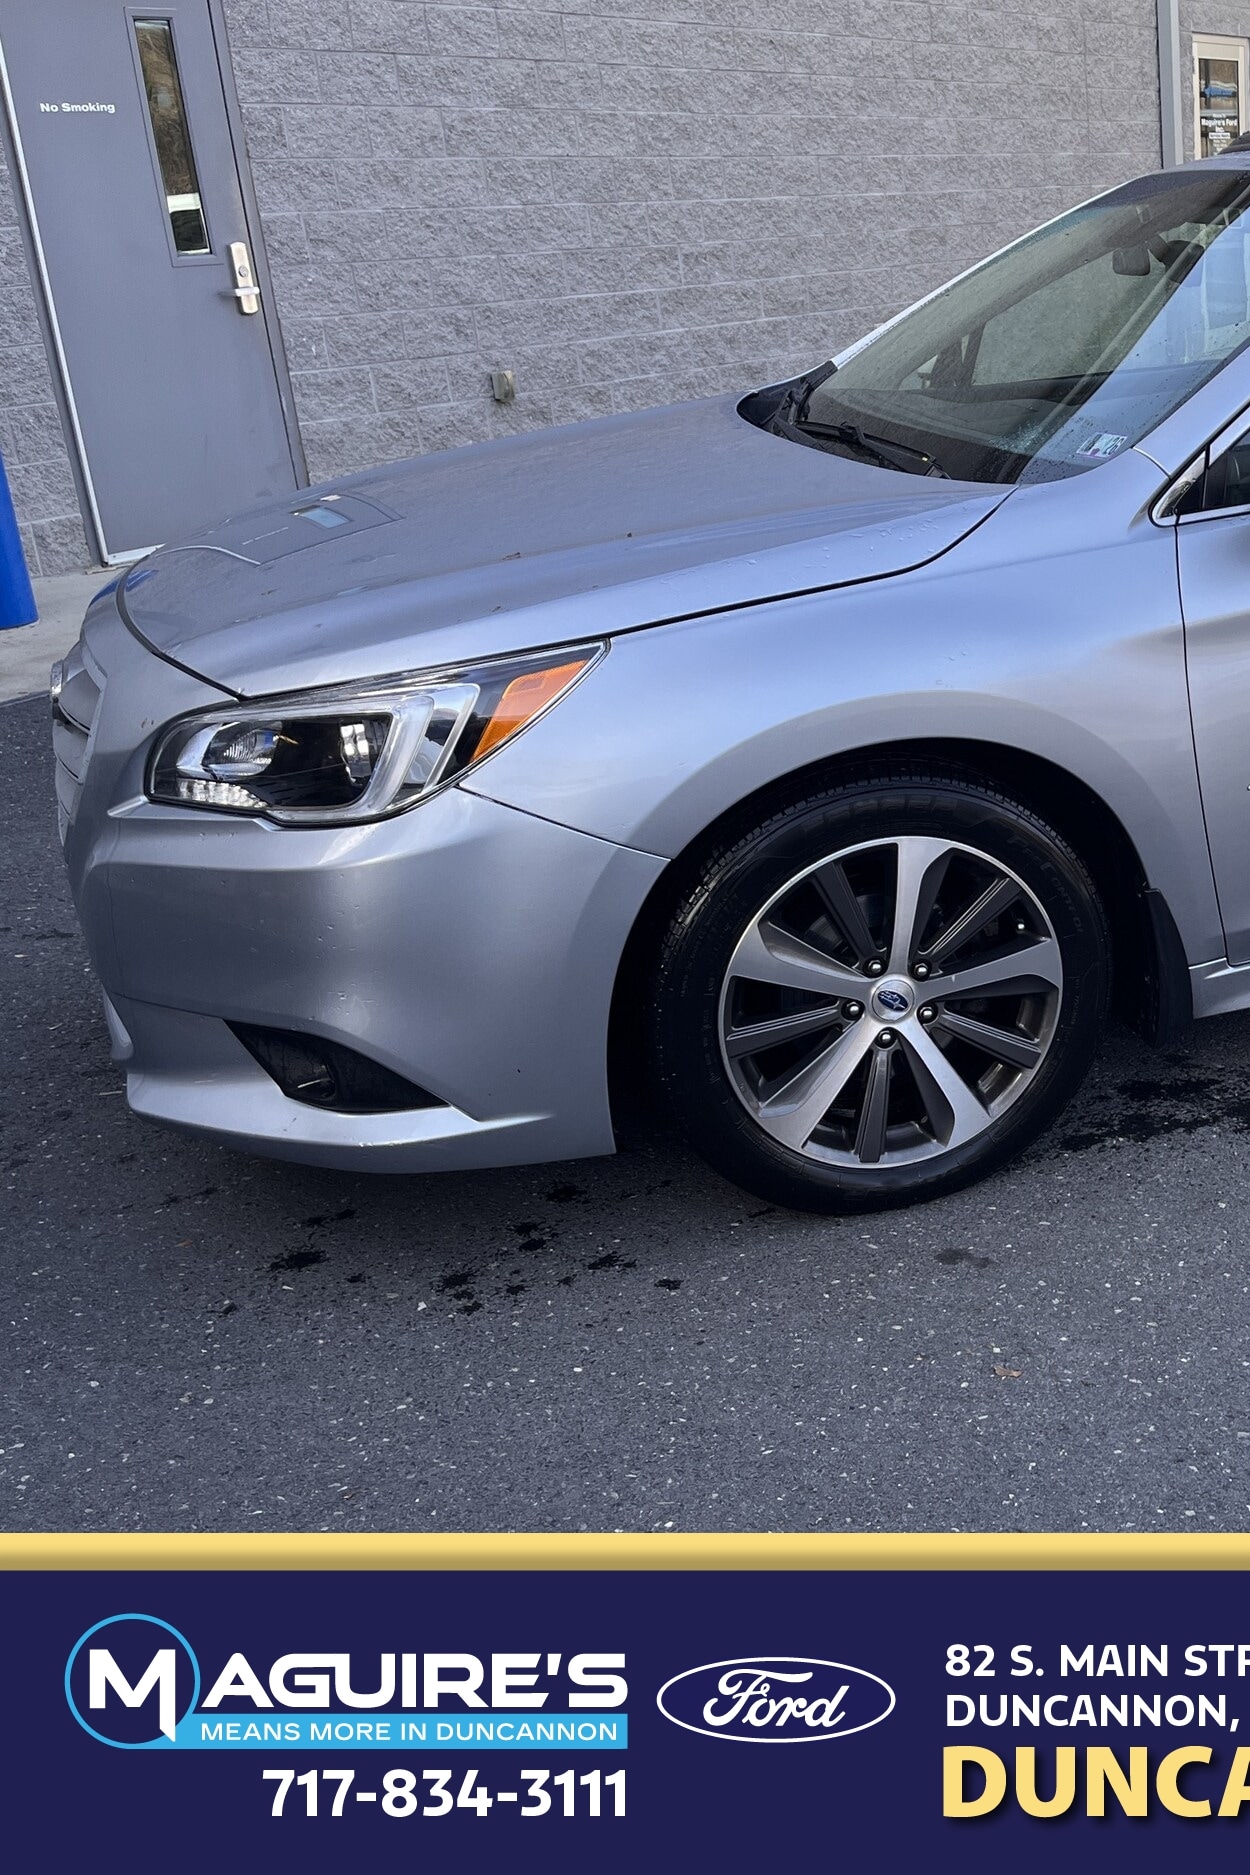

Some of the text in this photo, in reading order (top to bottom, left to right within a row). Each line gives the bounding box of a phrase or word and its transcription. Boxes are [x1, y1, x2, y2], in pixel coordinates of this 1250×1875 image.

[40, 102, 116, 114] No Smoking
[1225, 118, 1237, 127] Ford
